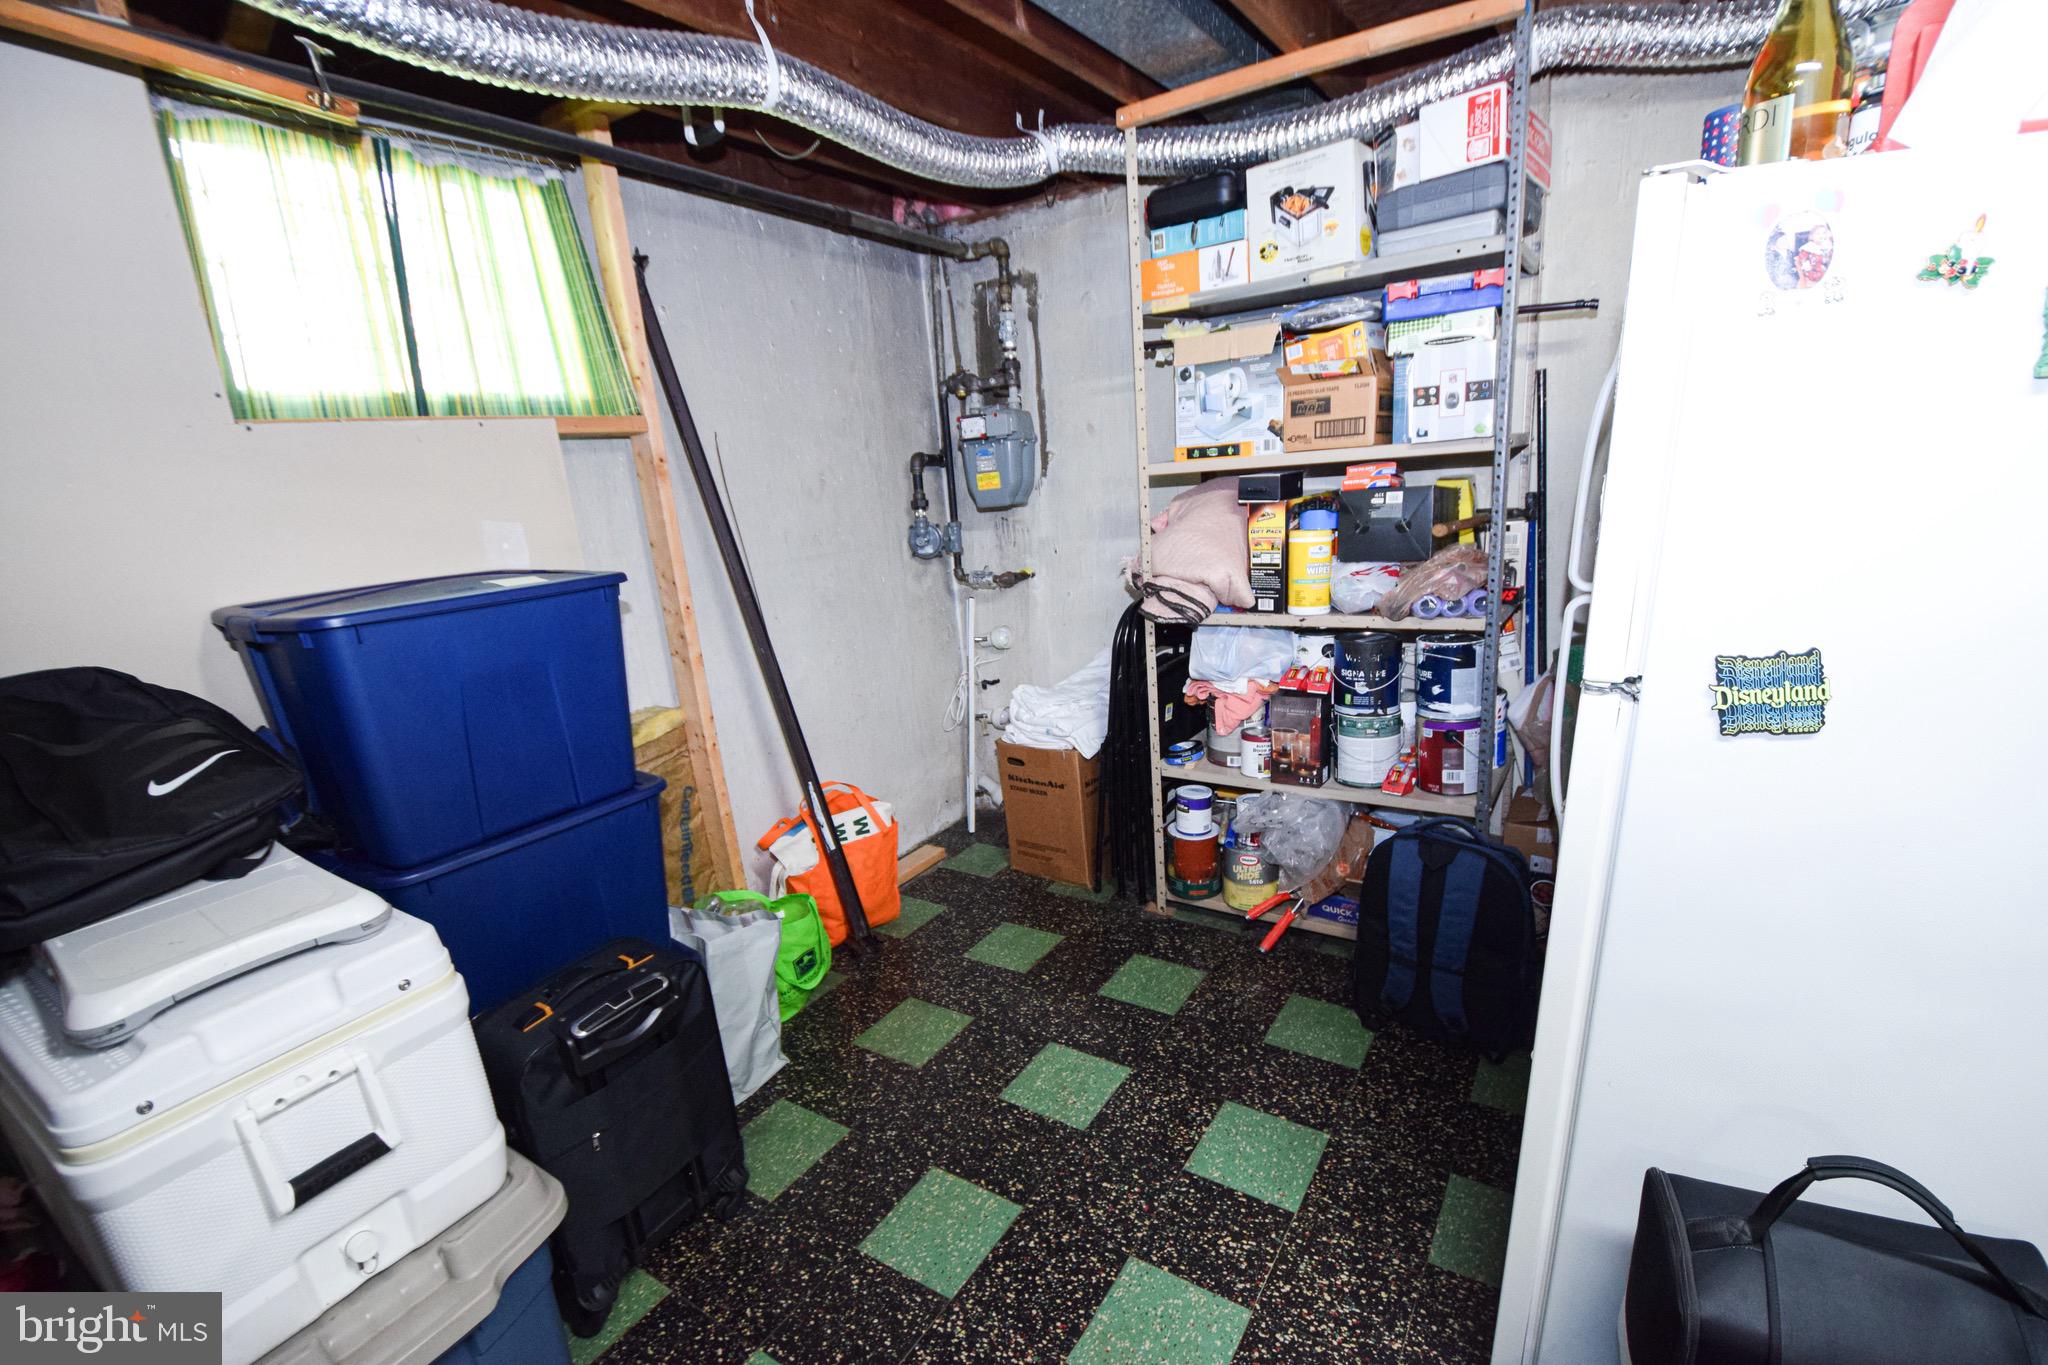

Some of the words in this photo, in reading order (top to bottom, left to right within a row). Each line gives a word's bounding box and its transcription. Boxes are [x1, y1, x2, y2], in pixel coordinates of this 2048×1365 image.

[1709, 679, 1831, 710] Disneyland
[1008, 774, 1065, 789] KitchenAid
[1236, 872, 1260, 881] HIDE
[1321, 904, 1353, 918] QUICK
